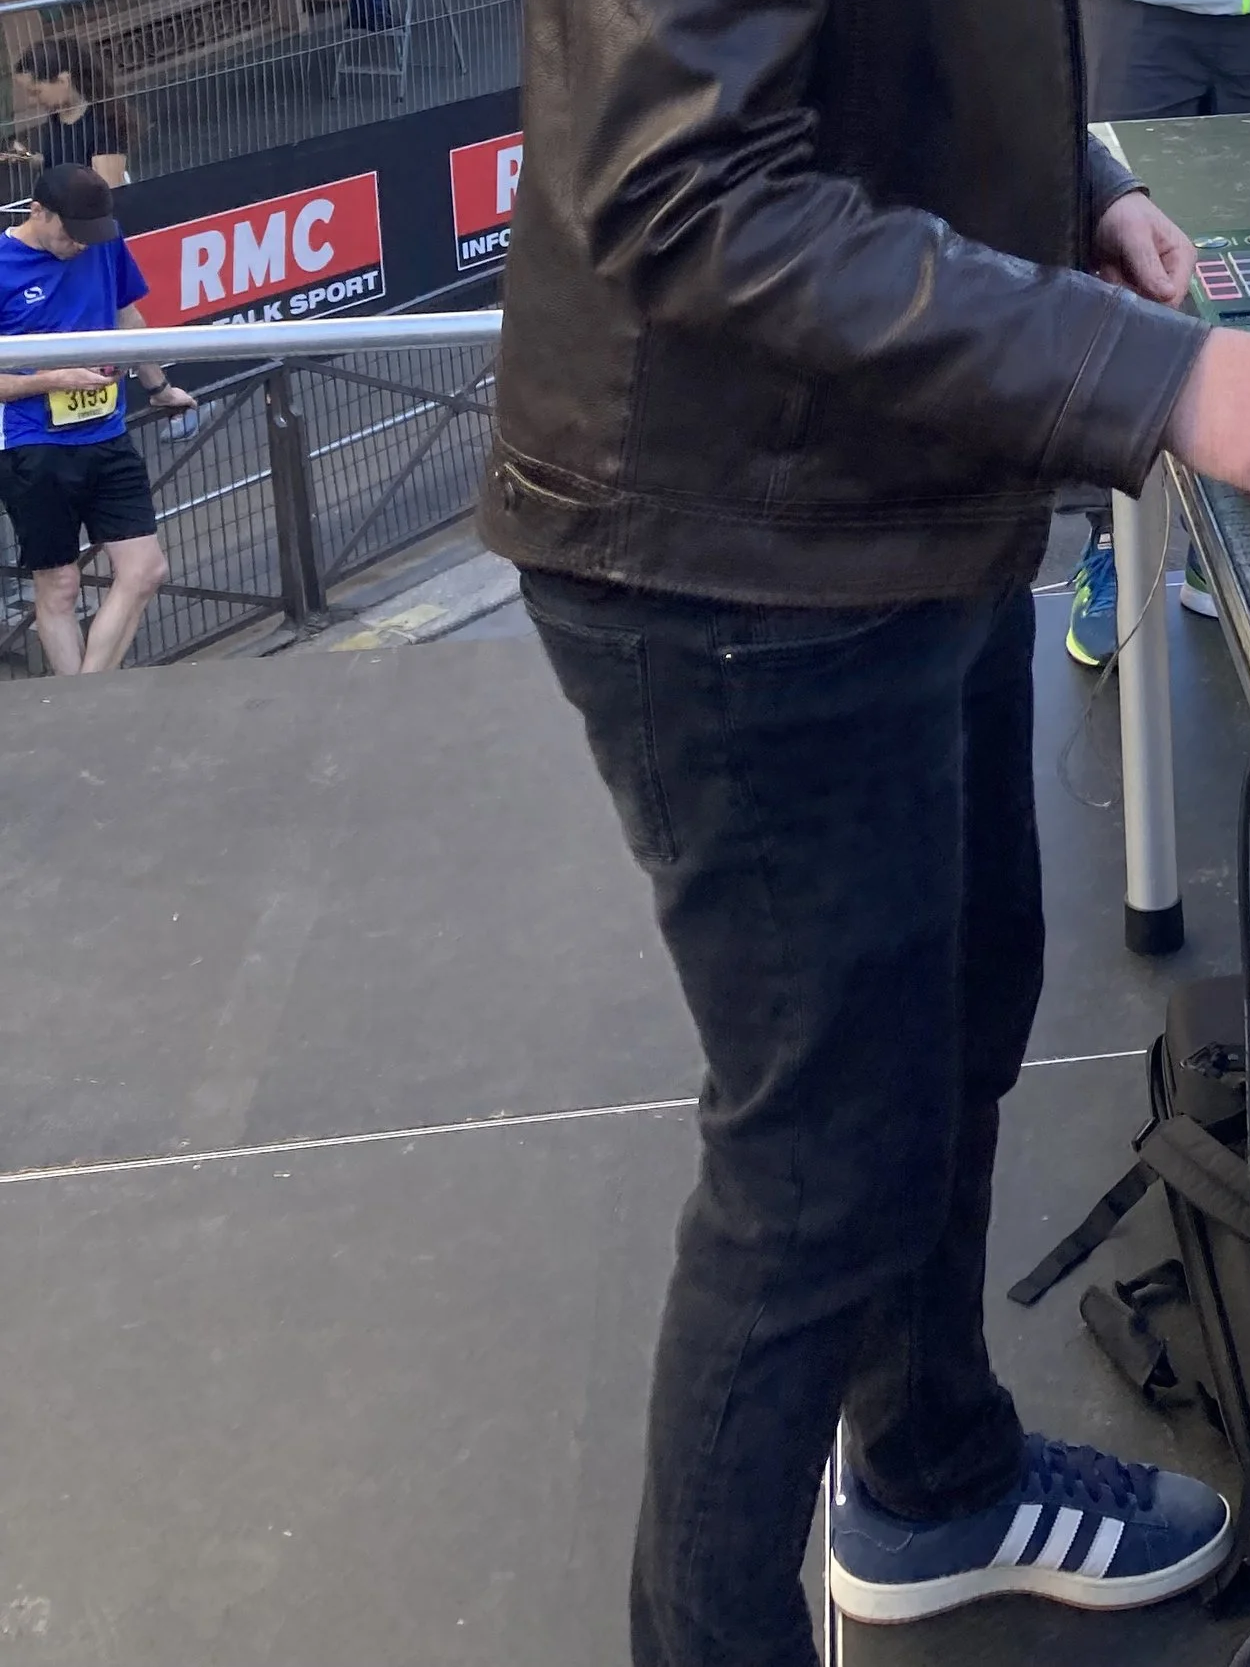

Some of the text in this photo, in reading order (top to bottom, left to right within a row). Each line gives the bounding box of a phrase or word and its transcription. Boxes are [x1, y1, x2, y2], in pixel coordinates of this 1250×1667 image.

[180, 198, 335, 310] RMC
[213, 270, 379, 325] ALK SPORT
